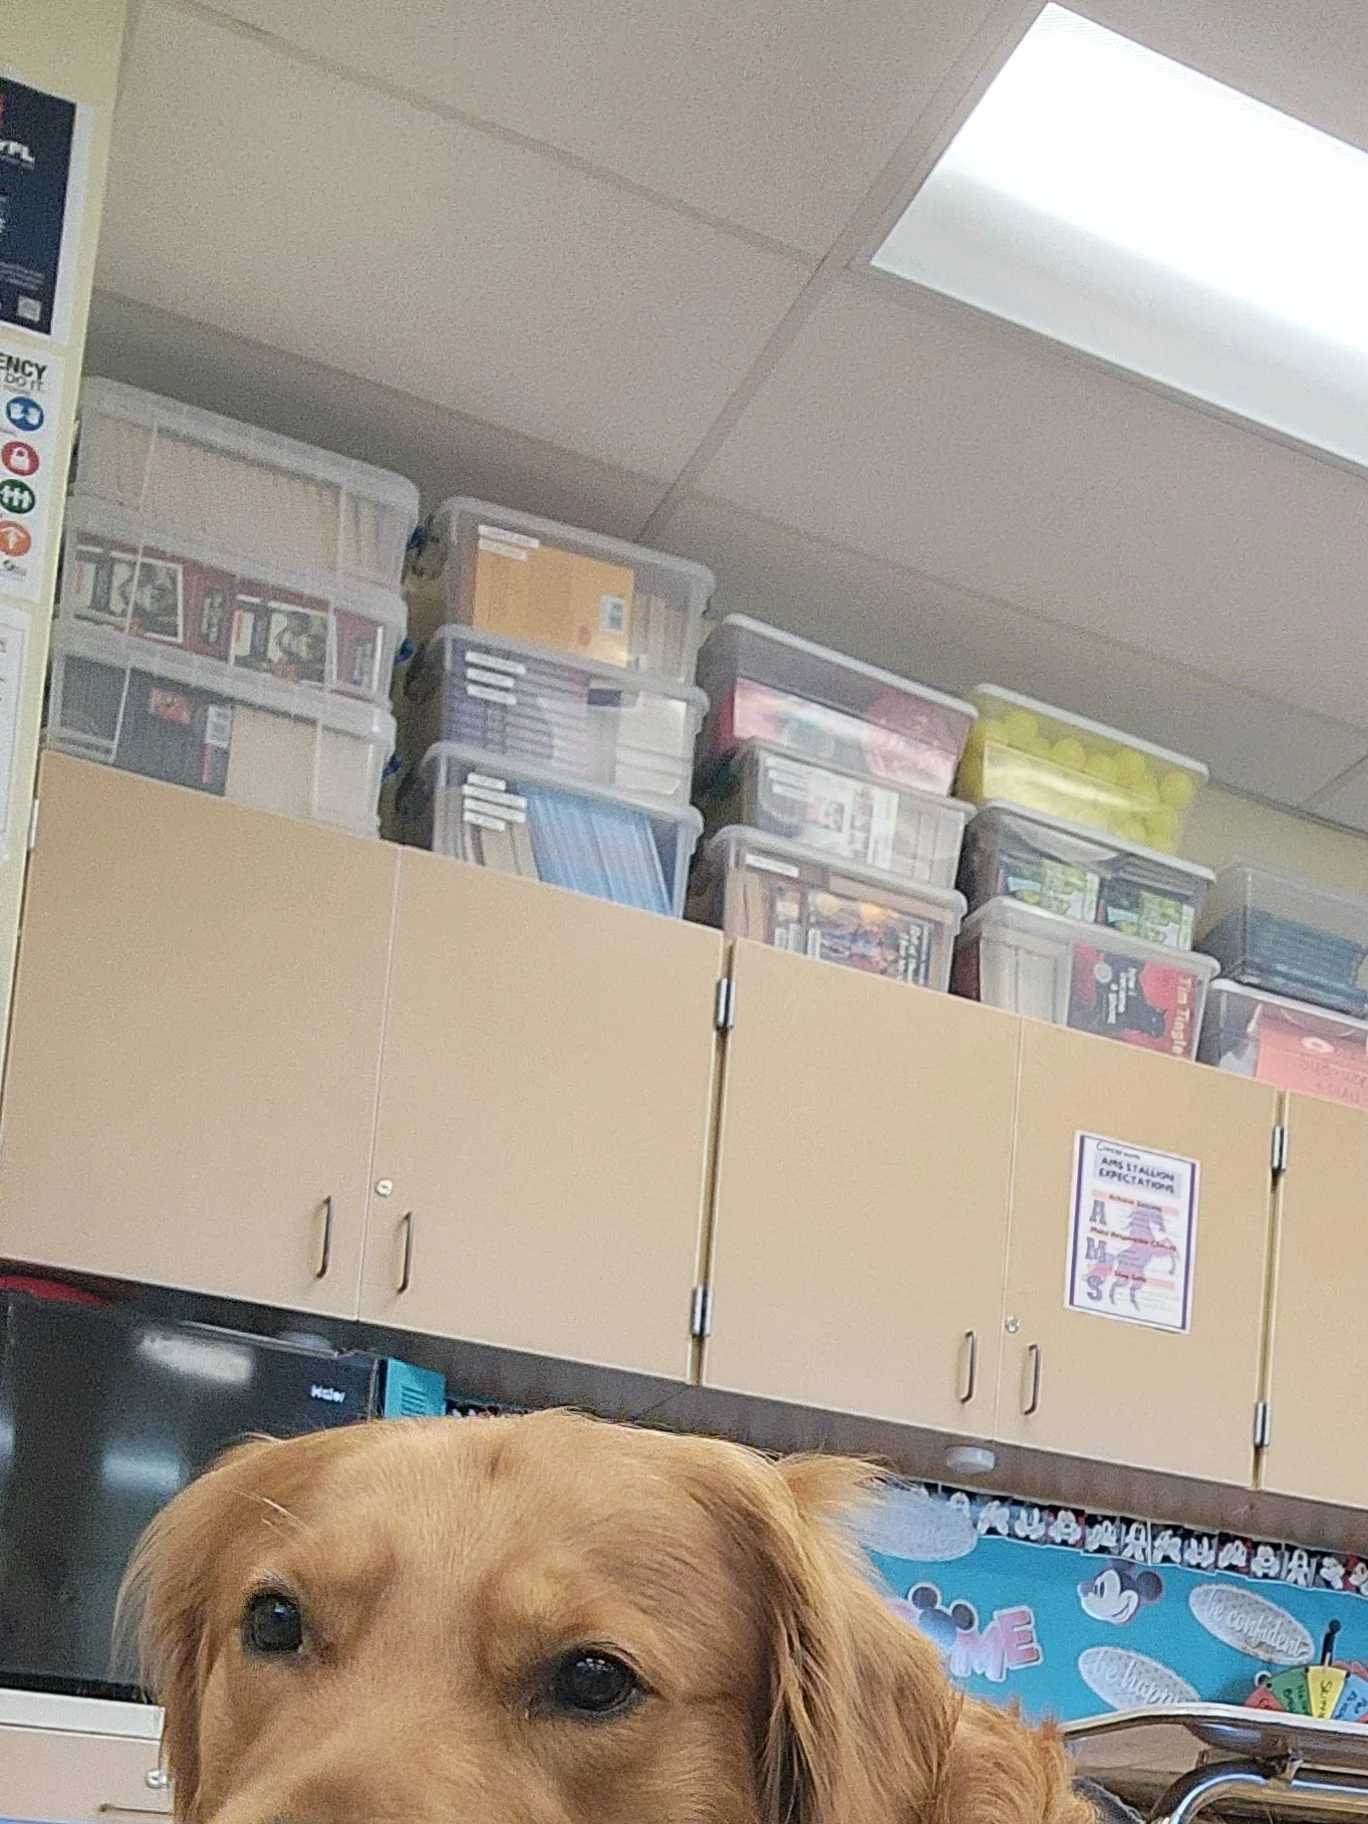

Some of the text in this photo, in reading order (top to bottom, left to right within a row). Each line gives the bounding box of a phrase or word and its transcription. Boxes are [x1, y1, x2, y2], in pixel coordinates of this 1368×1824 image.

[1098, 1167, 1175, 1194] EXPECTATIONS
[1101, 1156, 1175, 1182] AMS STALLION
[1089, 1199, 1107, 1226] A
[1085, 1236, 1107, 1263] M
[1086, 1275, 1104, 1301] S
[1227, 1609, 1310, 1658] confident
